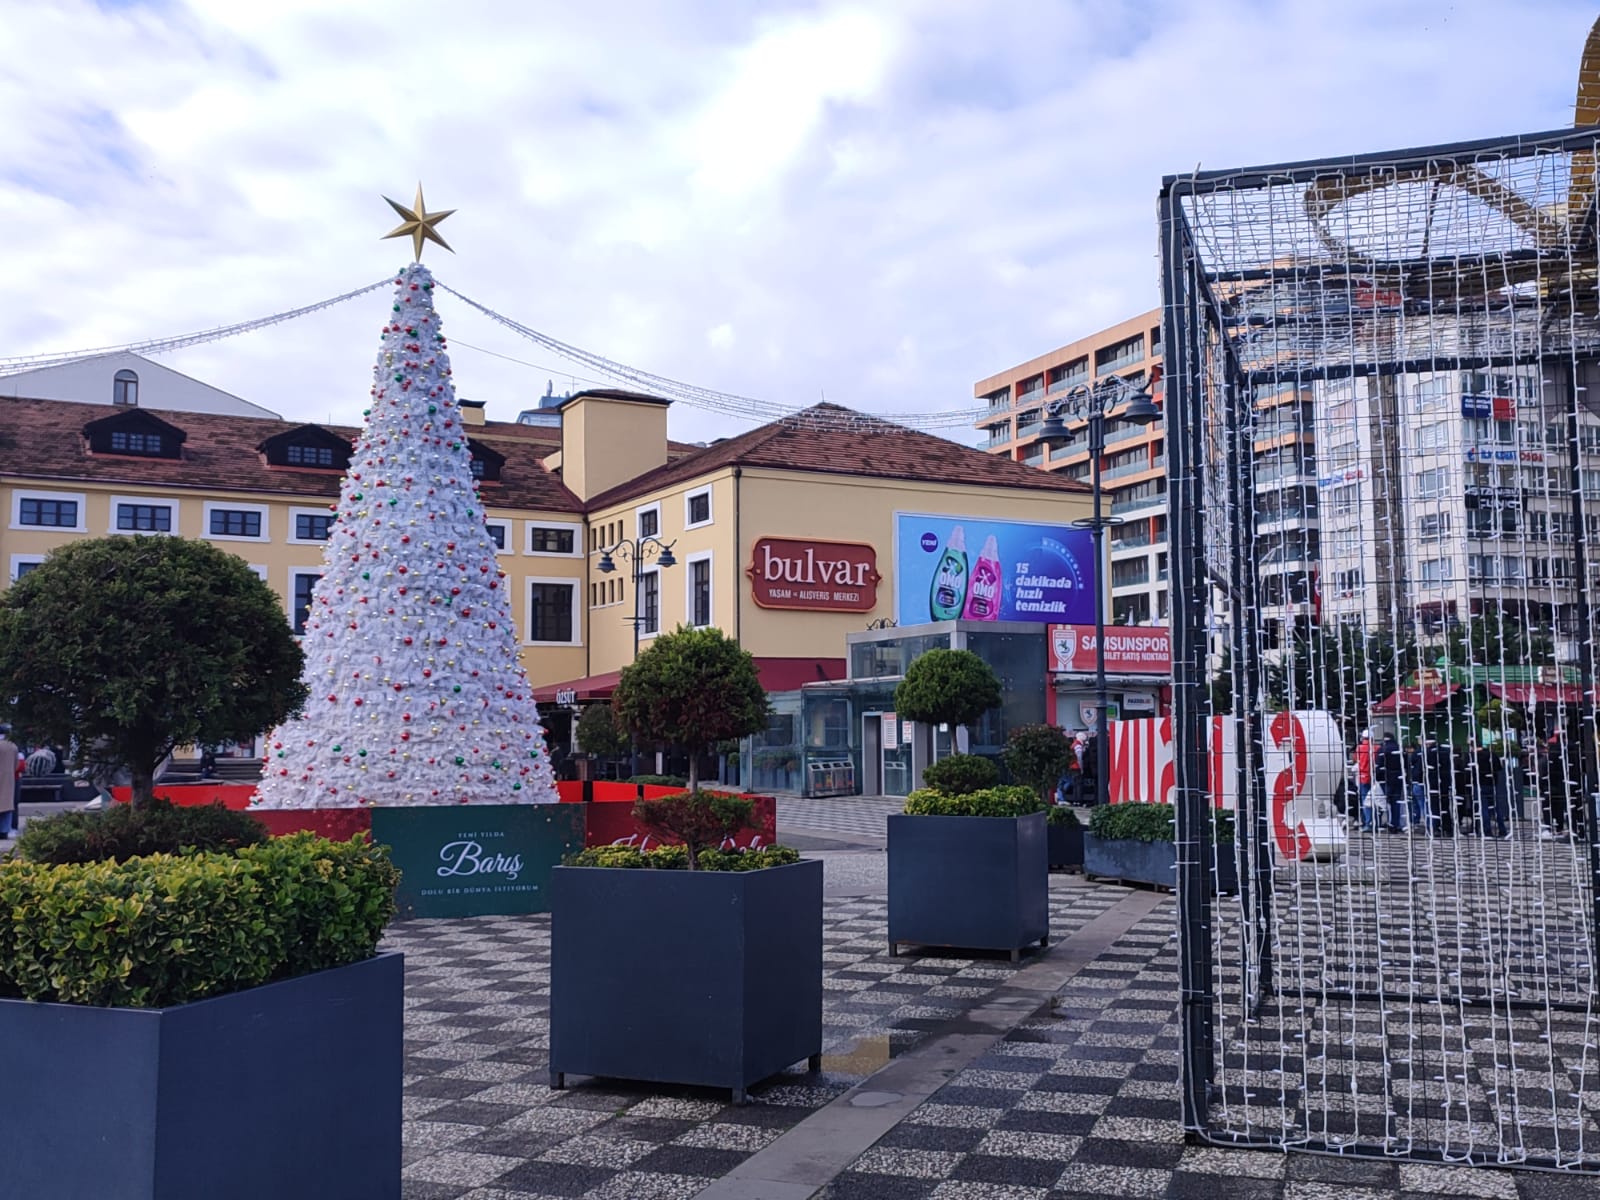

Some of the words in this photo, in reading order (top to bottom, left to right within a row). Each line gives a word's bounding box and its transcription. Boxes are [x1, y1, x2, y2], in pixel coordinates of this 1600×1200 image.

[762, 545, 870, 586] bulvar
[1015, 562, 1030, 574] 15
[940, 572, 961, 588] OMO
[1015, 575, 1072, 589] dakikada
[973, 581, 995, 598] OMO
[1015, 587, 1043, 599] hızlı
[1015, 600, 1067, 613] temizlik
[437, 840, 524, 881] Barış
